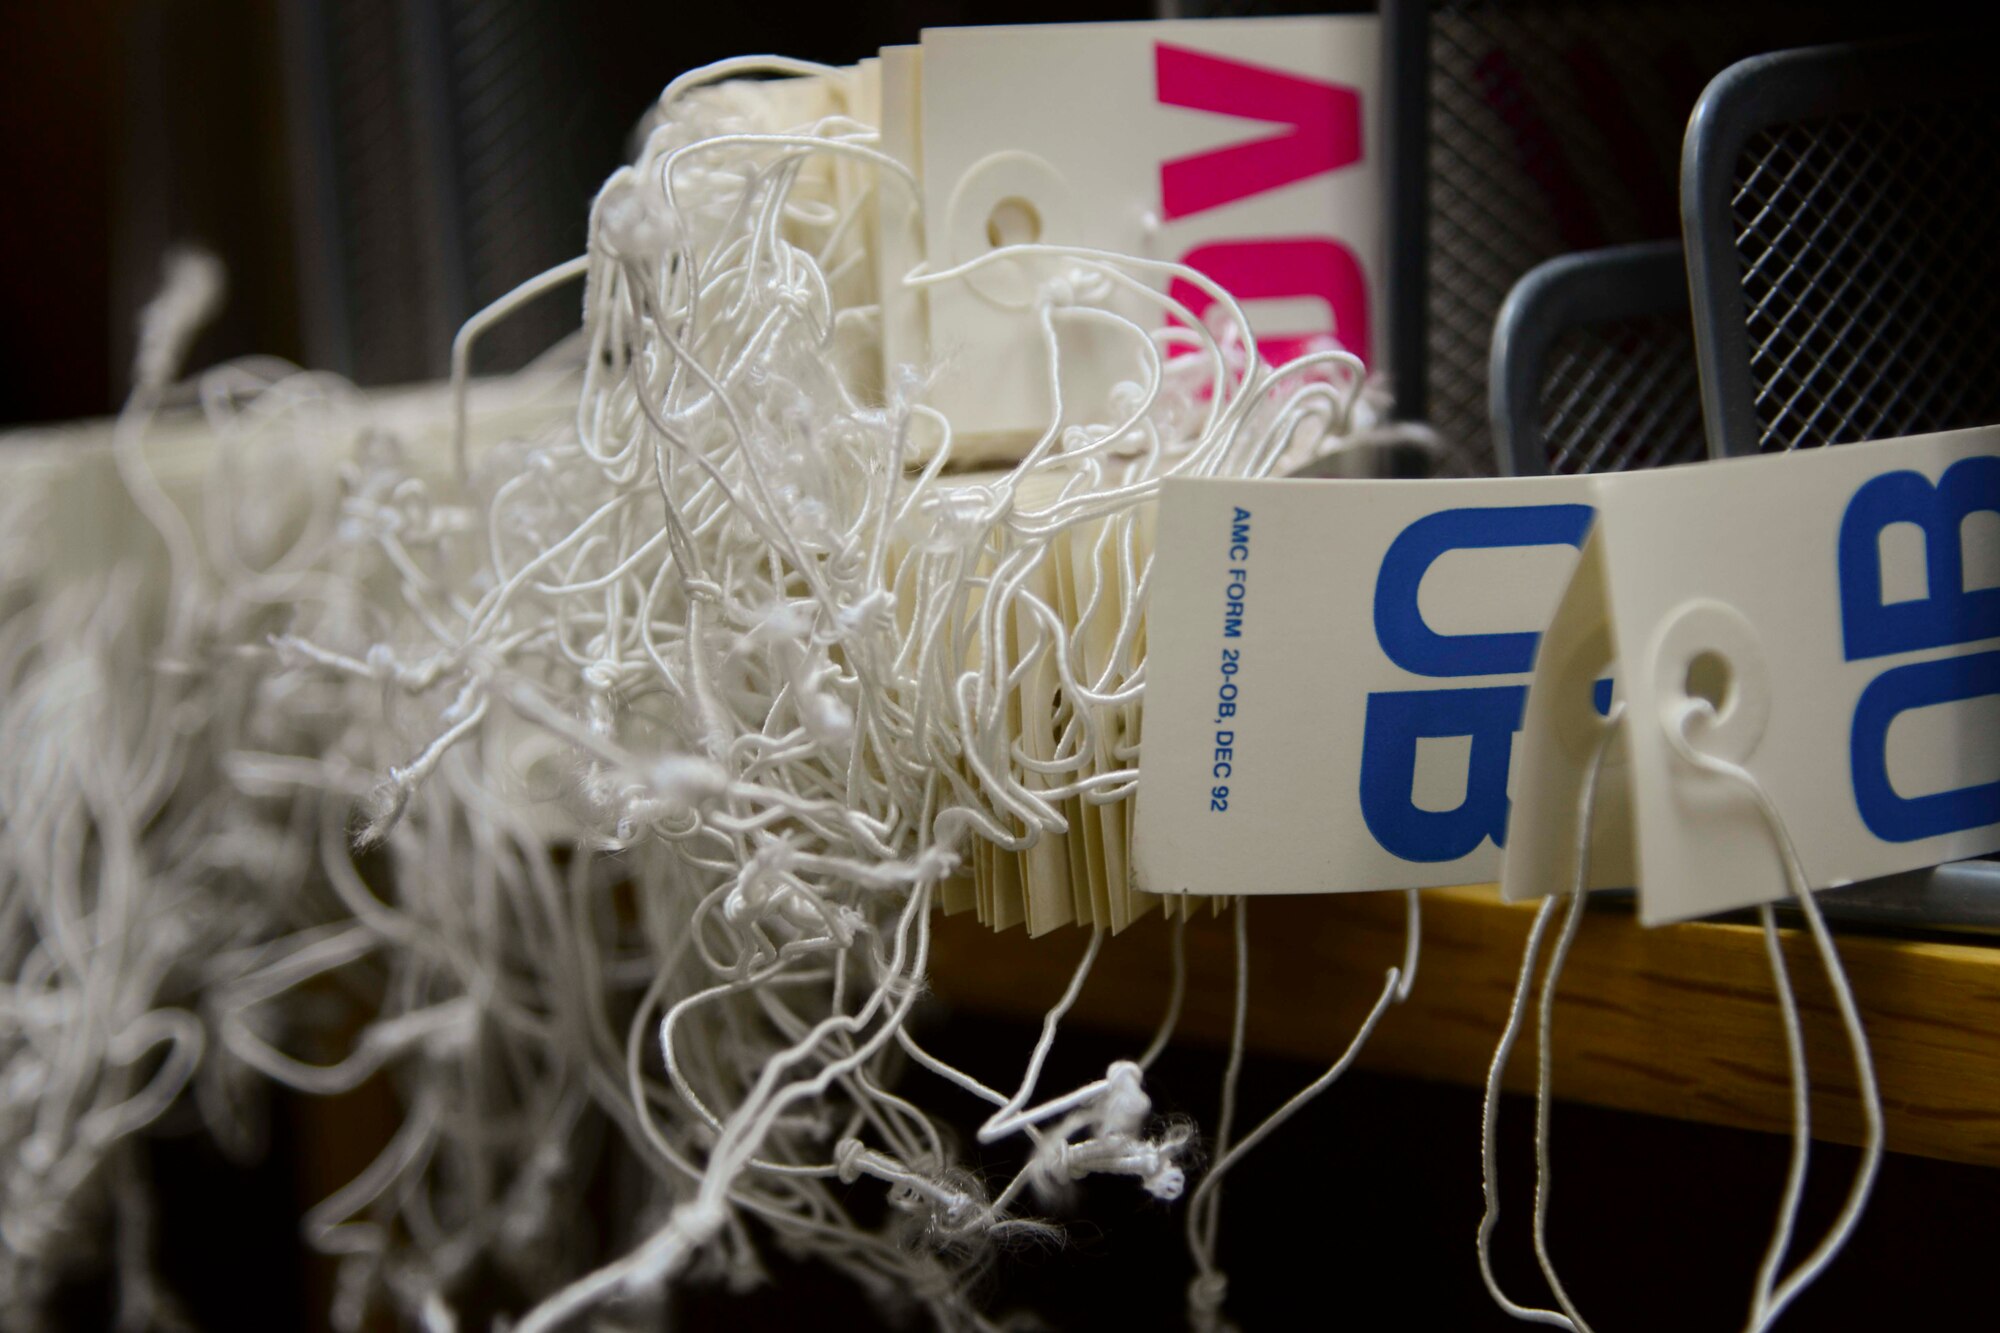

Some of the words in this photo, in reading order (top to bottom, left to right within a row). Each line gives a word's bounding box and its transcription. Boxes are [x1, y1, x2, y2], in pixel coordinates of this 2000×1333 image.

[1228, 506, 1251, 562] AMC
[1223, 568, 1246, 640] FORM
[1836, 456, 2000, 843] OB
[1214, 648, 1239, 725] 20-OB,
[1212, 730, 1234, 780] DEC
[1209, 785, 1230, 813] 92
